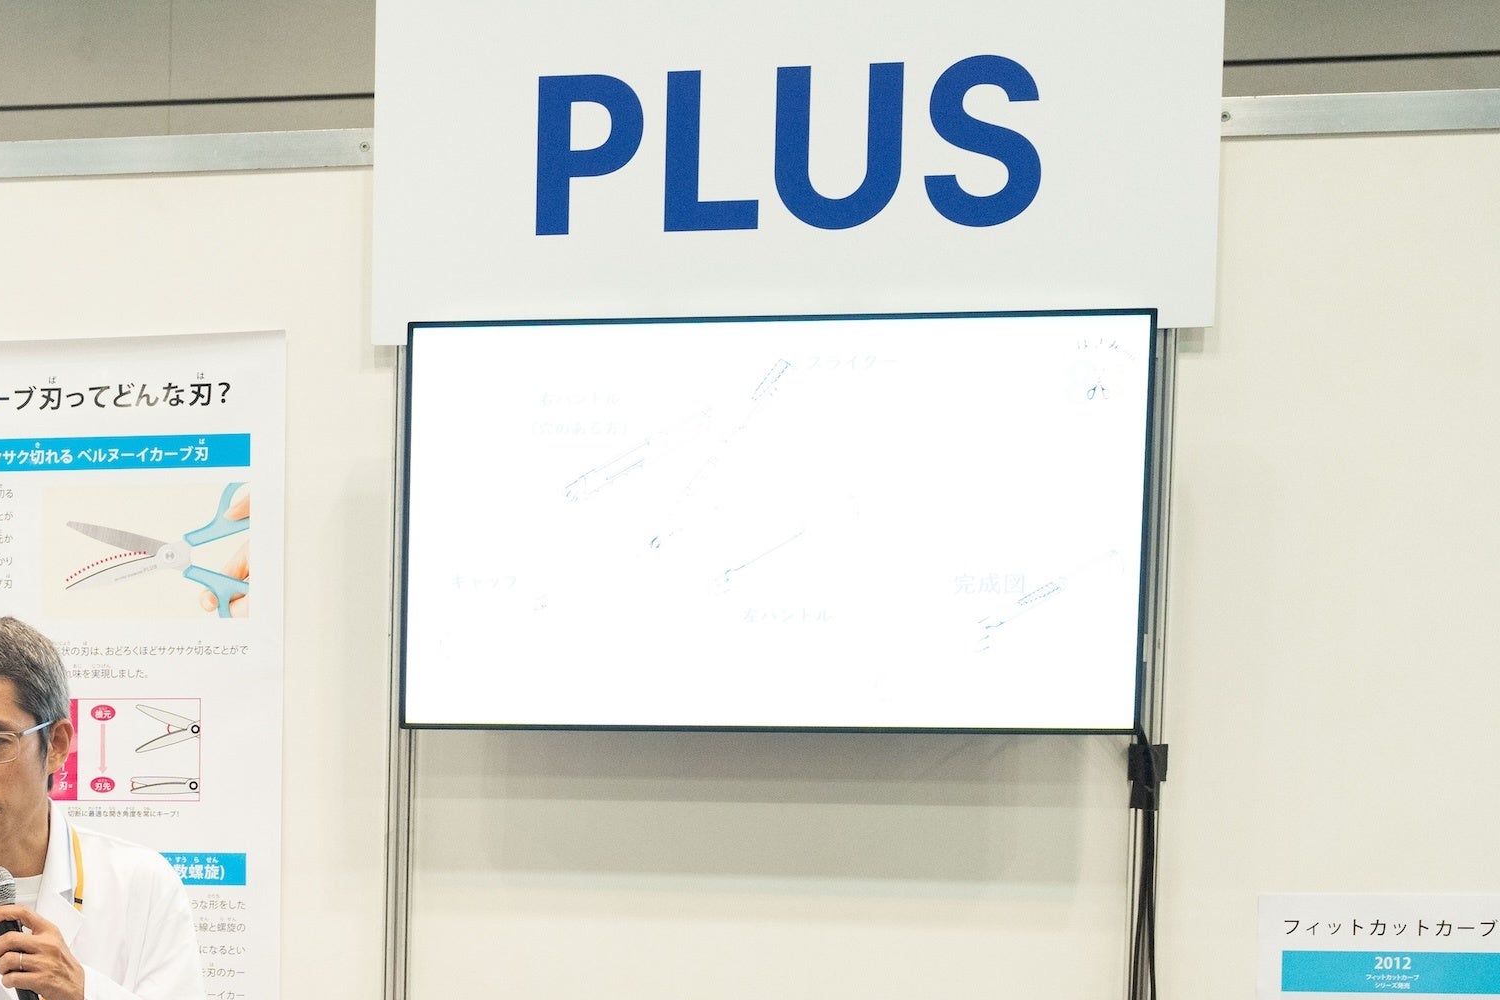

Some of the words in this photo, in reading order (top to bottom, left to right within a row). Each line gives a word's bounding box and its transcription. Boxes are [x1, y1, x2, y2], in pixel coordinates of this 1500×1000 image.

[535, 54, 1042, 236] PLUS
[77, 445, 209, 464] ベルヌーイカーブ刃
[953, 571, 1026, 595] 完成図
[1284, 918, 1500, 938] フィットカットカーブ
[1374, 957, 1412, 970] 2012
